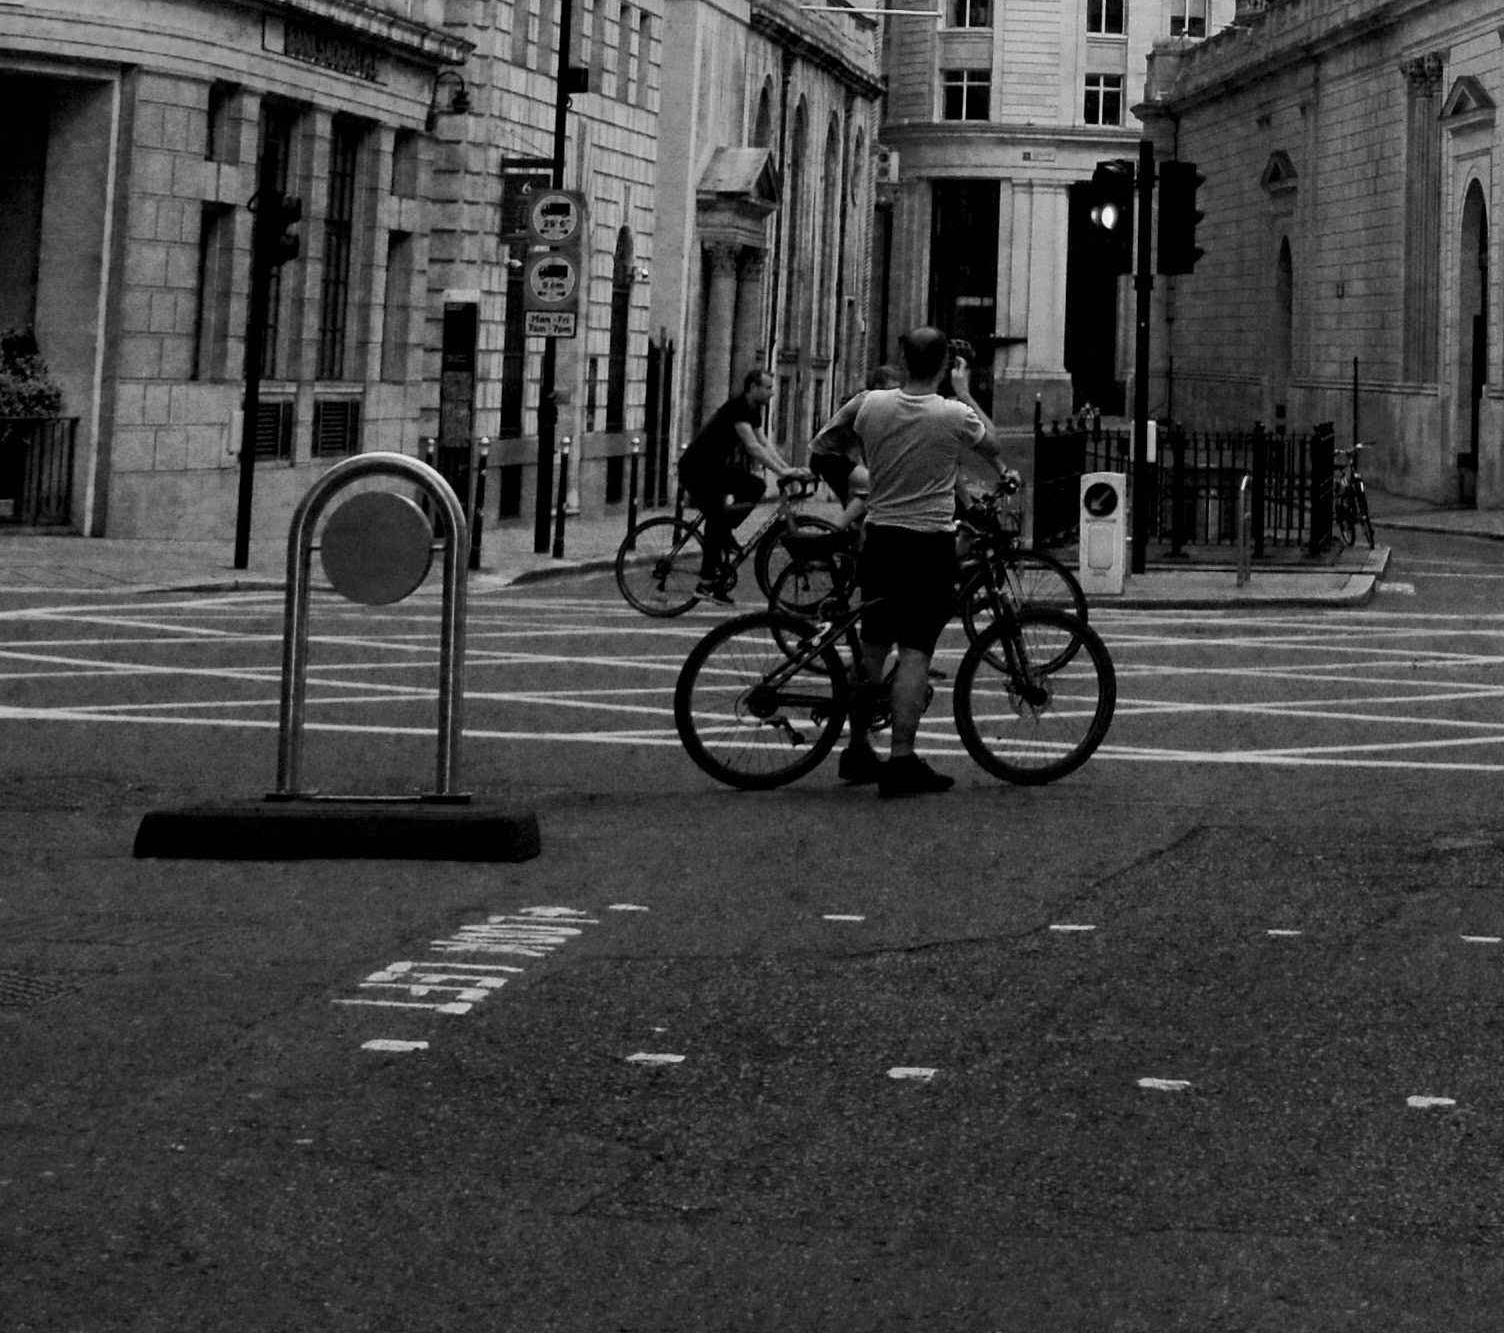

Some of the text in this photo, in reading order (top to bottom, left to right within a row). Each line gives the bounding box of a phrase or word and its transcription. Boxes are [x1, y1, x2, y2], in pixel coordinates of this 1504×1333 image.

[531, 315, 551, 323] Mon
[557, 315, 570, 323] Fri
[553, 325, 572, 333] 7pm
